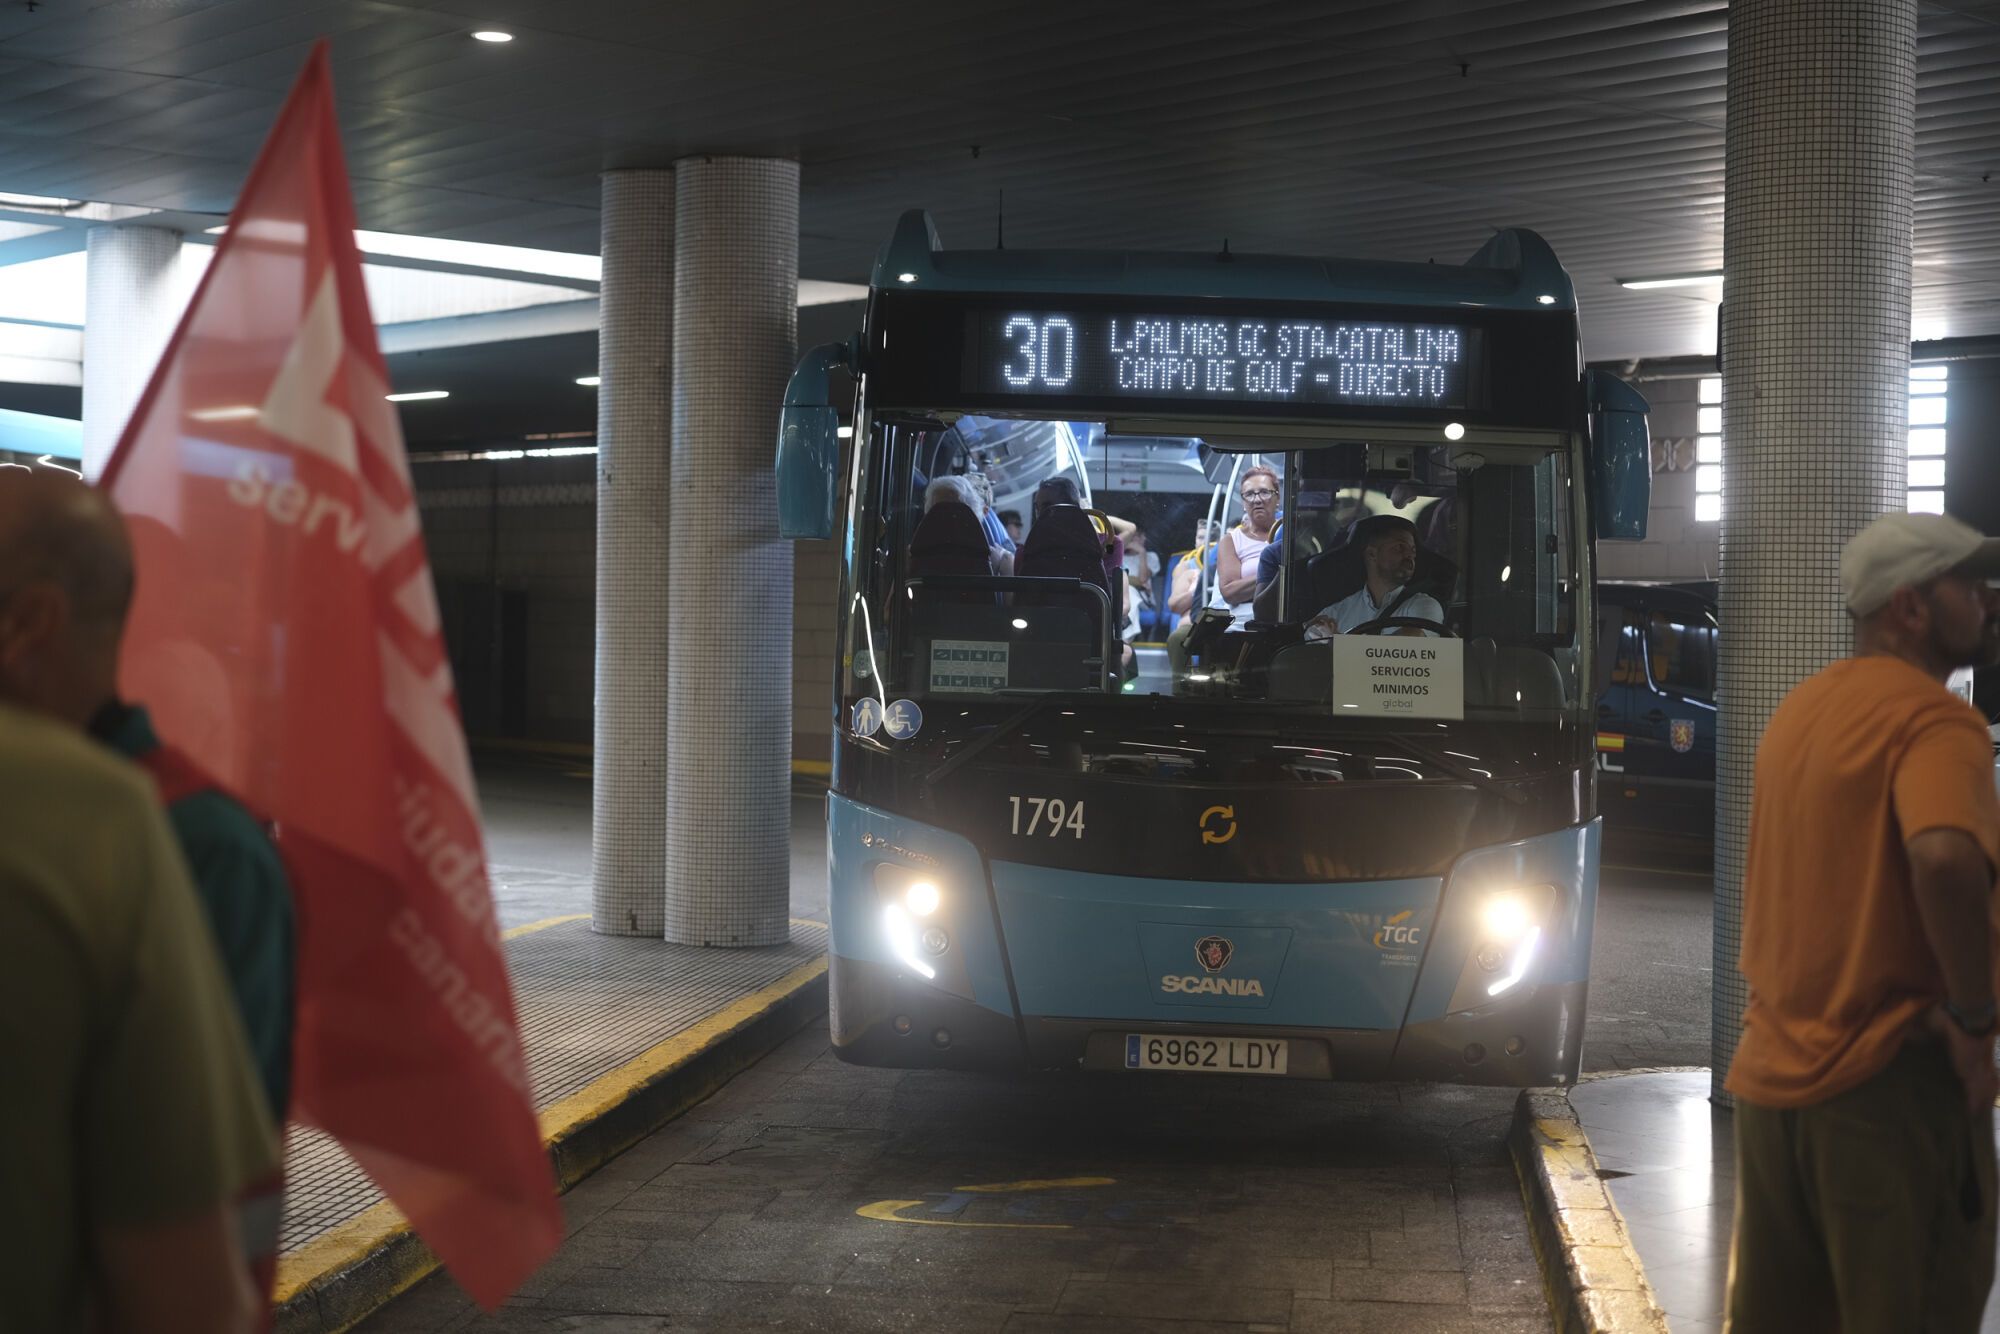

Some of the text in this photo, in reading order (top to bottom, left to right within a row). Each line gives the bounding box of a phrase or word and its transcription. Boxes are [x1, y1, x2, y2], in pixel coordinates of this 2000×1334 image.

[1111, 320, 1228, 356] L.PALMAS
[1238, 324, 1268, 357] GC
[1003, 316, 1074, 387] 30
[1119, 356, 1196, 391] CAMPO
[1206, 358, 1237, 392] DE
[1246, 360, 1306, 393] GOLF
[1339, 362, 1445, 397] DIRECTO
[1365, 647, 1436, 660] GUAGUA EN
[1371, 665, 1431, 678] SERVICIOS
[1373, 683, 1429, 696] MINIMOS
[1382, 699, 1413, 709] global
[1009, 796, 1085, 839] 1794
[1382, 925, 1420, 944] TGC
[1161, 974, 1264, 997] SCANIA
[1148, 1039, 1218, 1067] 6962
[1229, 1042, 1280, 1070] LDY
